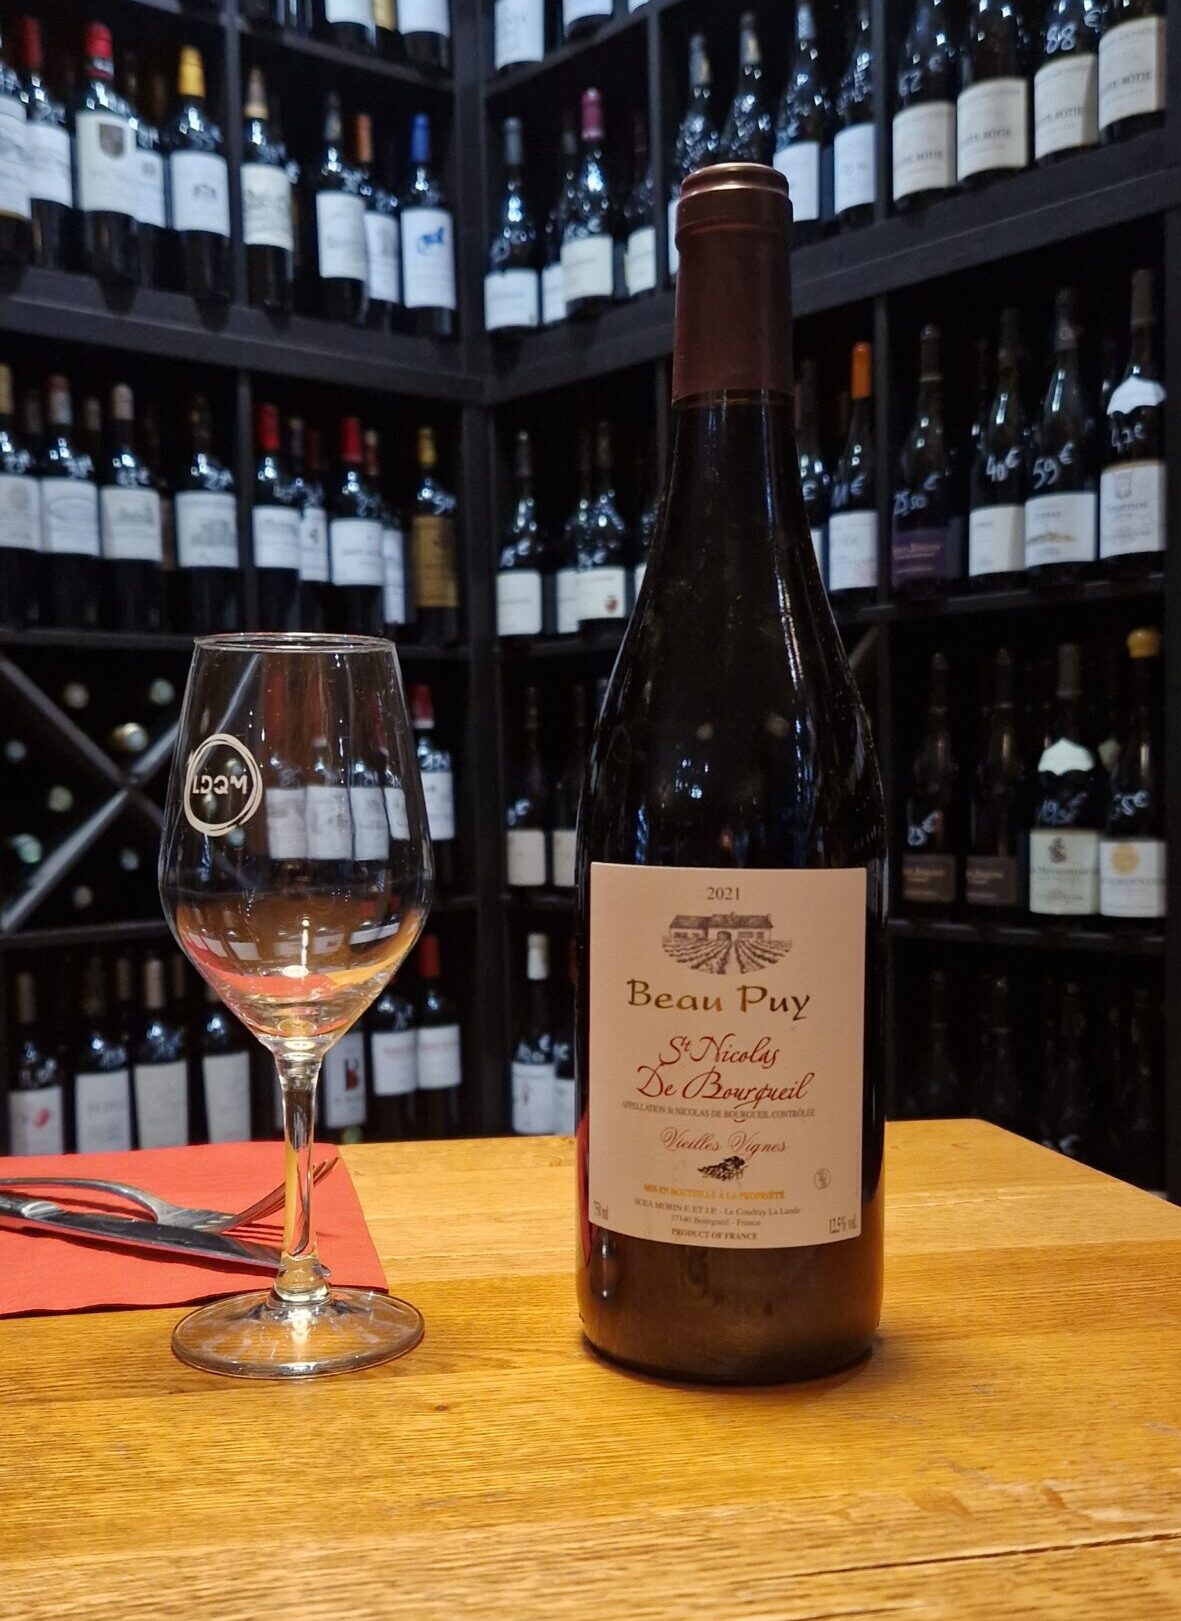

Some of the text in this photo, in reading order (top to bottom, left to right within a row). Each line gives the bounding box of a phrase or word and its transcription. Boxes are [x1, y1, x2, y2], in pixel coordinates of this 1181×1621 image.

[706, 887, 740, 900] 2021
[627, 978, 810, 1021] Beau Puy
[658, 1033, 781, 1069] St Nicolas
[637, 1065, 815, 1118] De Bourgueil
[621, 1100, 666, 1115] APPELLATION
[675, 1107, 710, 1118] NICOLAS
[711, 1110, 723, 1118] DE
[724, 1109, 770, 1119] BOURGUEIL
[660, 1127, 787, 1159] Vieilles Vignes
[724, 1207, 735, 1215] Le
[671, 1227, 758, 1241] PRODUCT OF FRANCE
